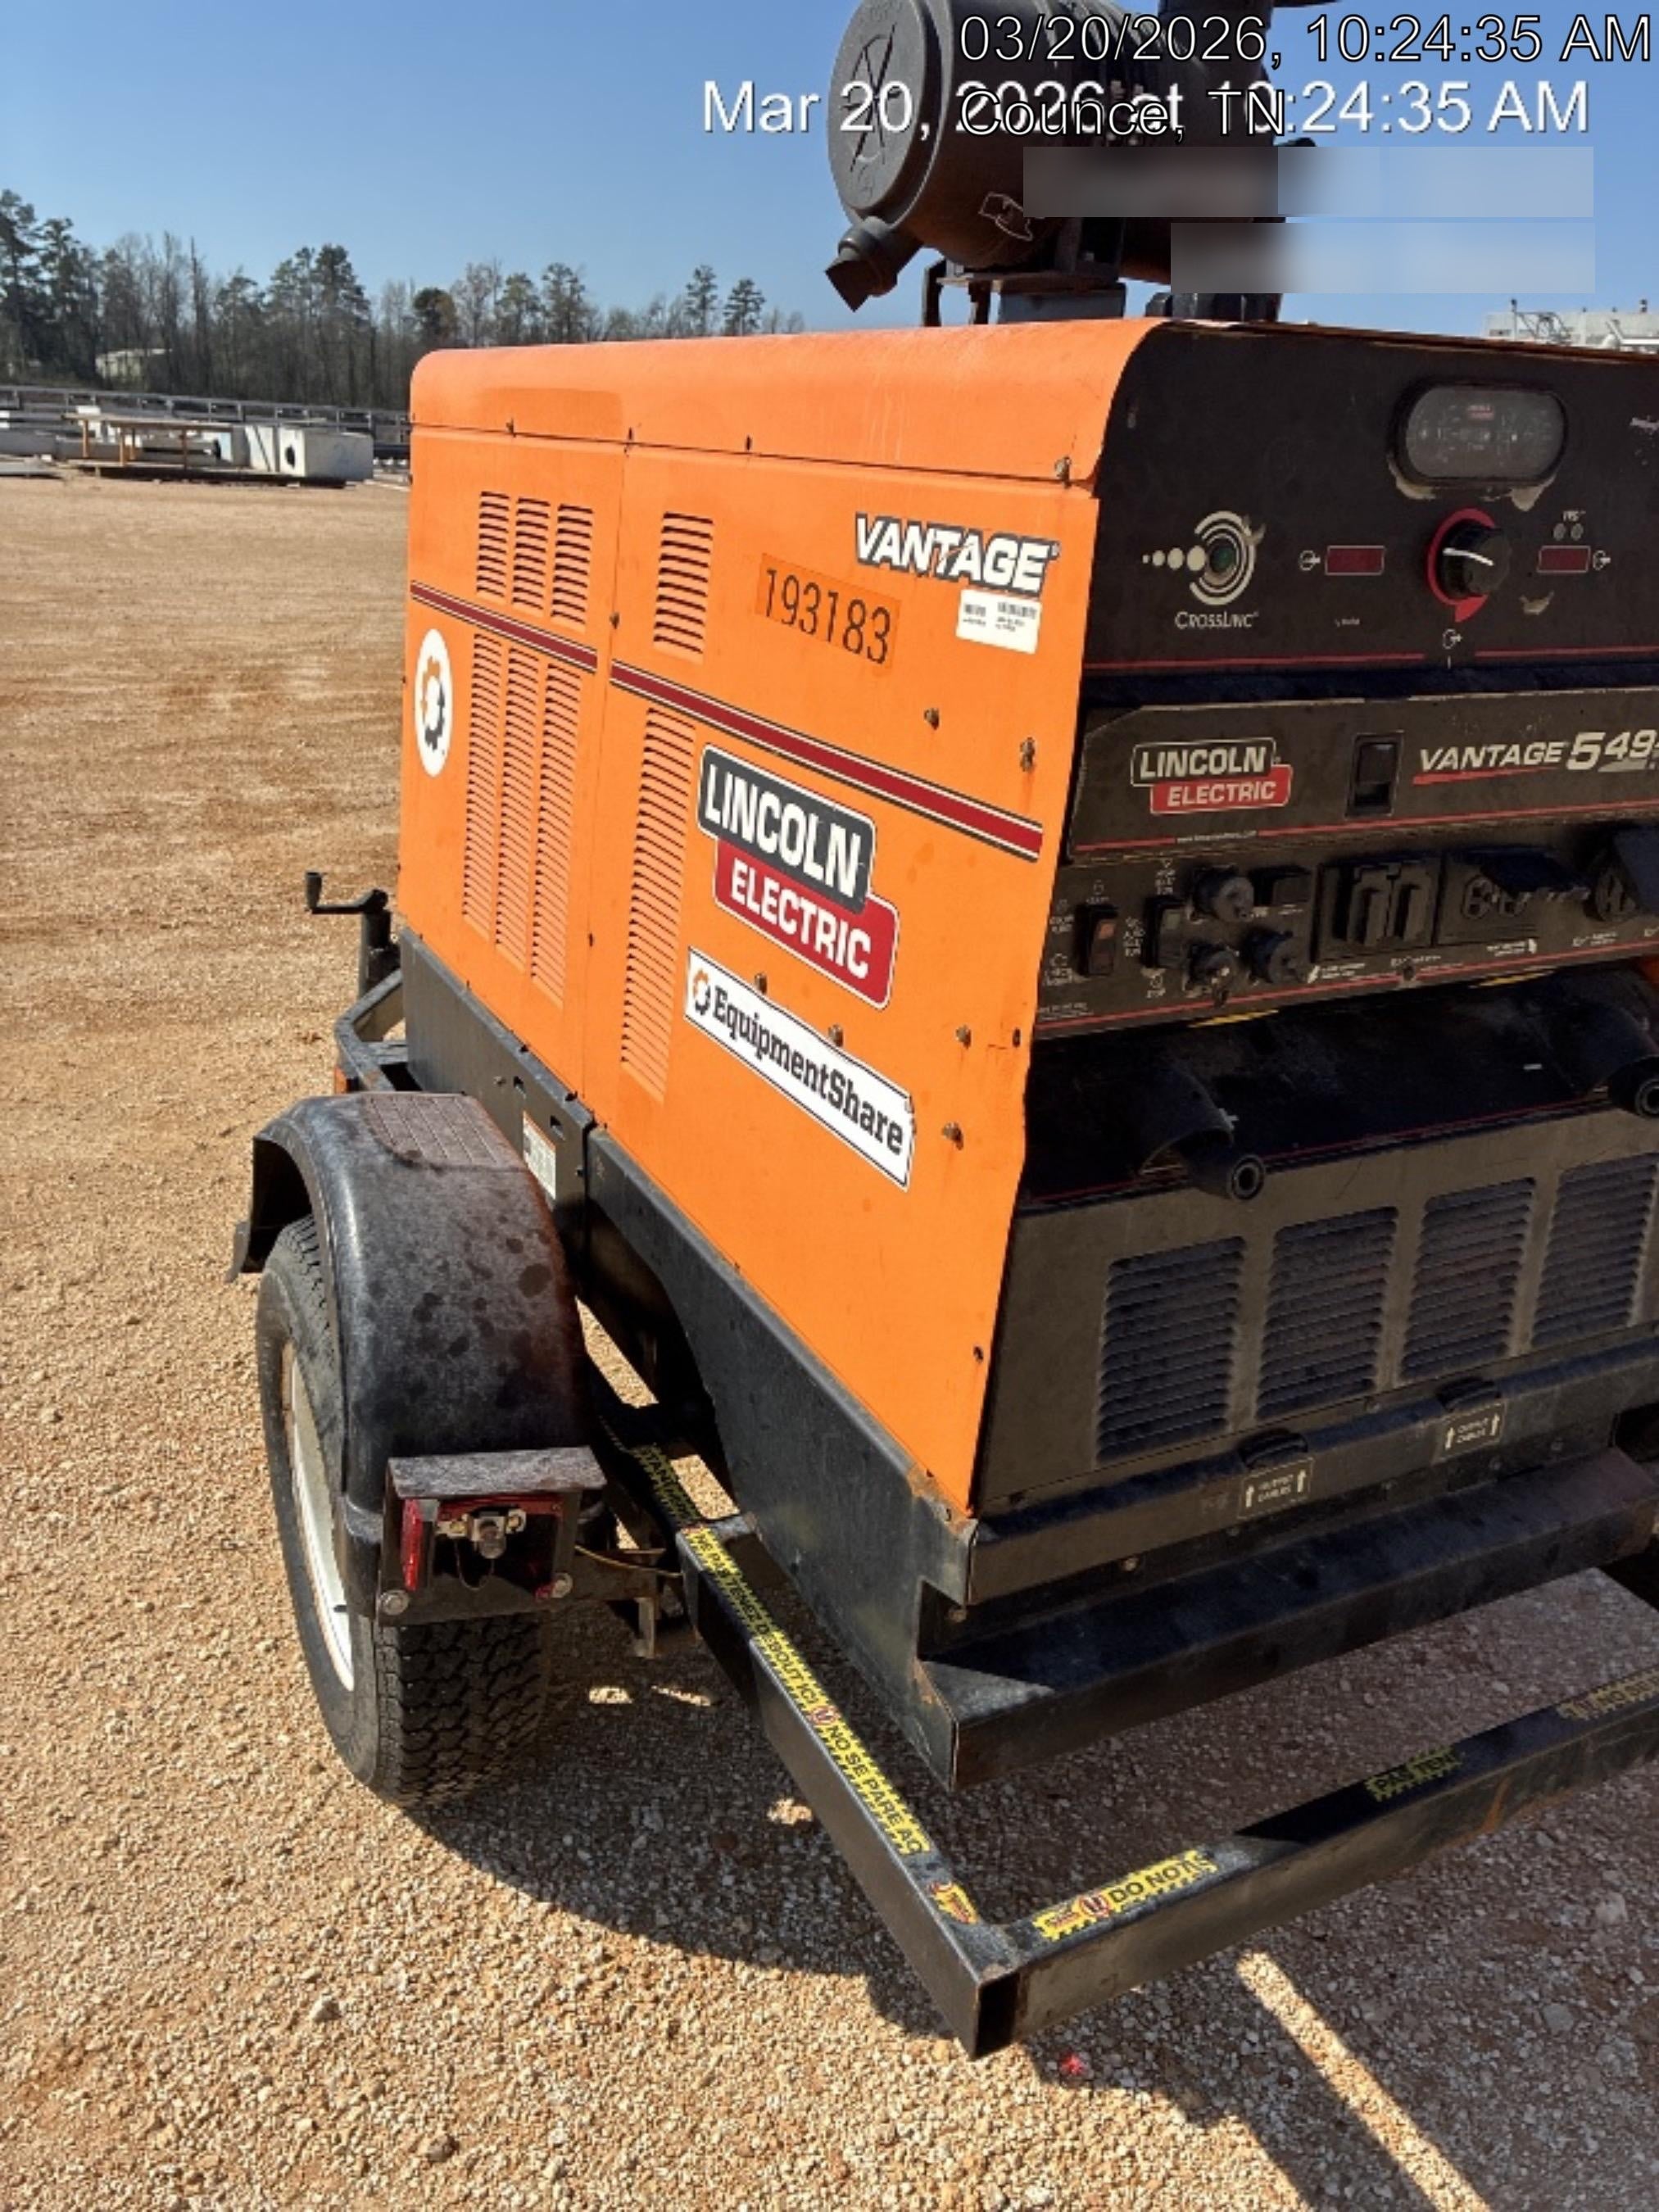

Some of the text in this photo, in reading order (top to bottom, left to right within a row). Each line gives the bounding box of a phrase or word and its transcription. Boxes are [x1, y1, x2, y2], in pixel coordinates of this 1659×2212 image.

[856, 513, 1048, 596] VANTAGE
[765, 569, 891, 664] 193183
[1139, 744, 1267, 779] LINCOLN
[1167, 779, 1277, 808] ELECTRIC
[1420, 741, 1566, 771] VANTAGE
[705, 763, 861, 898] LINCOLN
[729, 857, 871, 979] ELECTRIC
[712, 985, 902, 1156] EquipmentShare
[827, 1725, 850, 1750] NO
[845, 1752, 868, 1777] SE
[863, 1778, 904, 1826] PARE
[1108, 1881, 1145, 1904] DO
